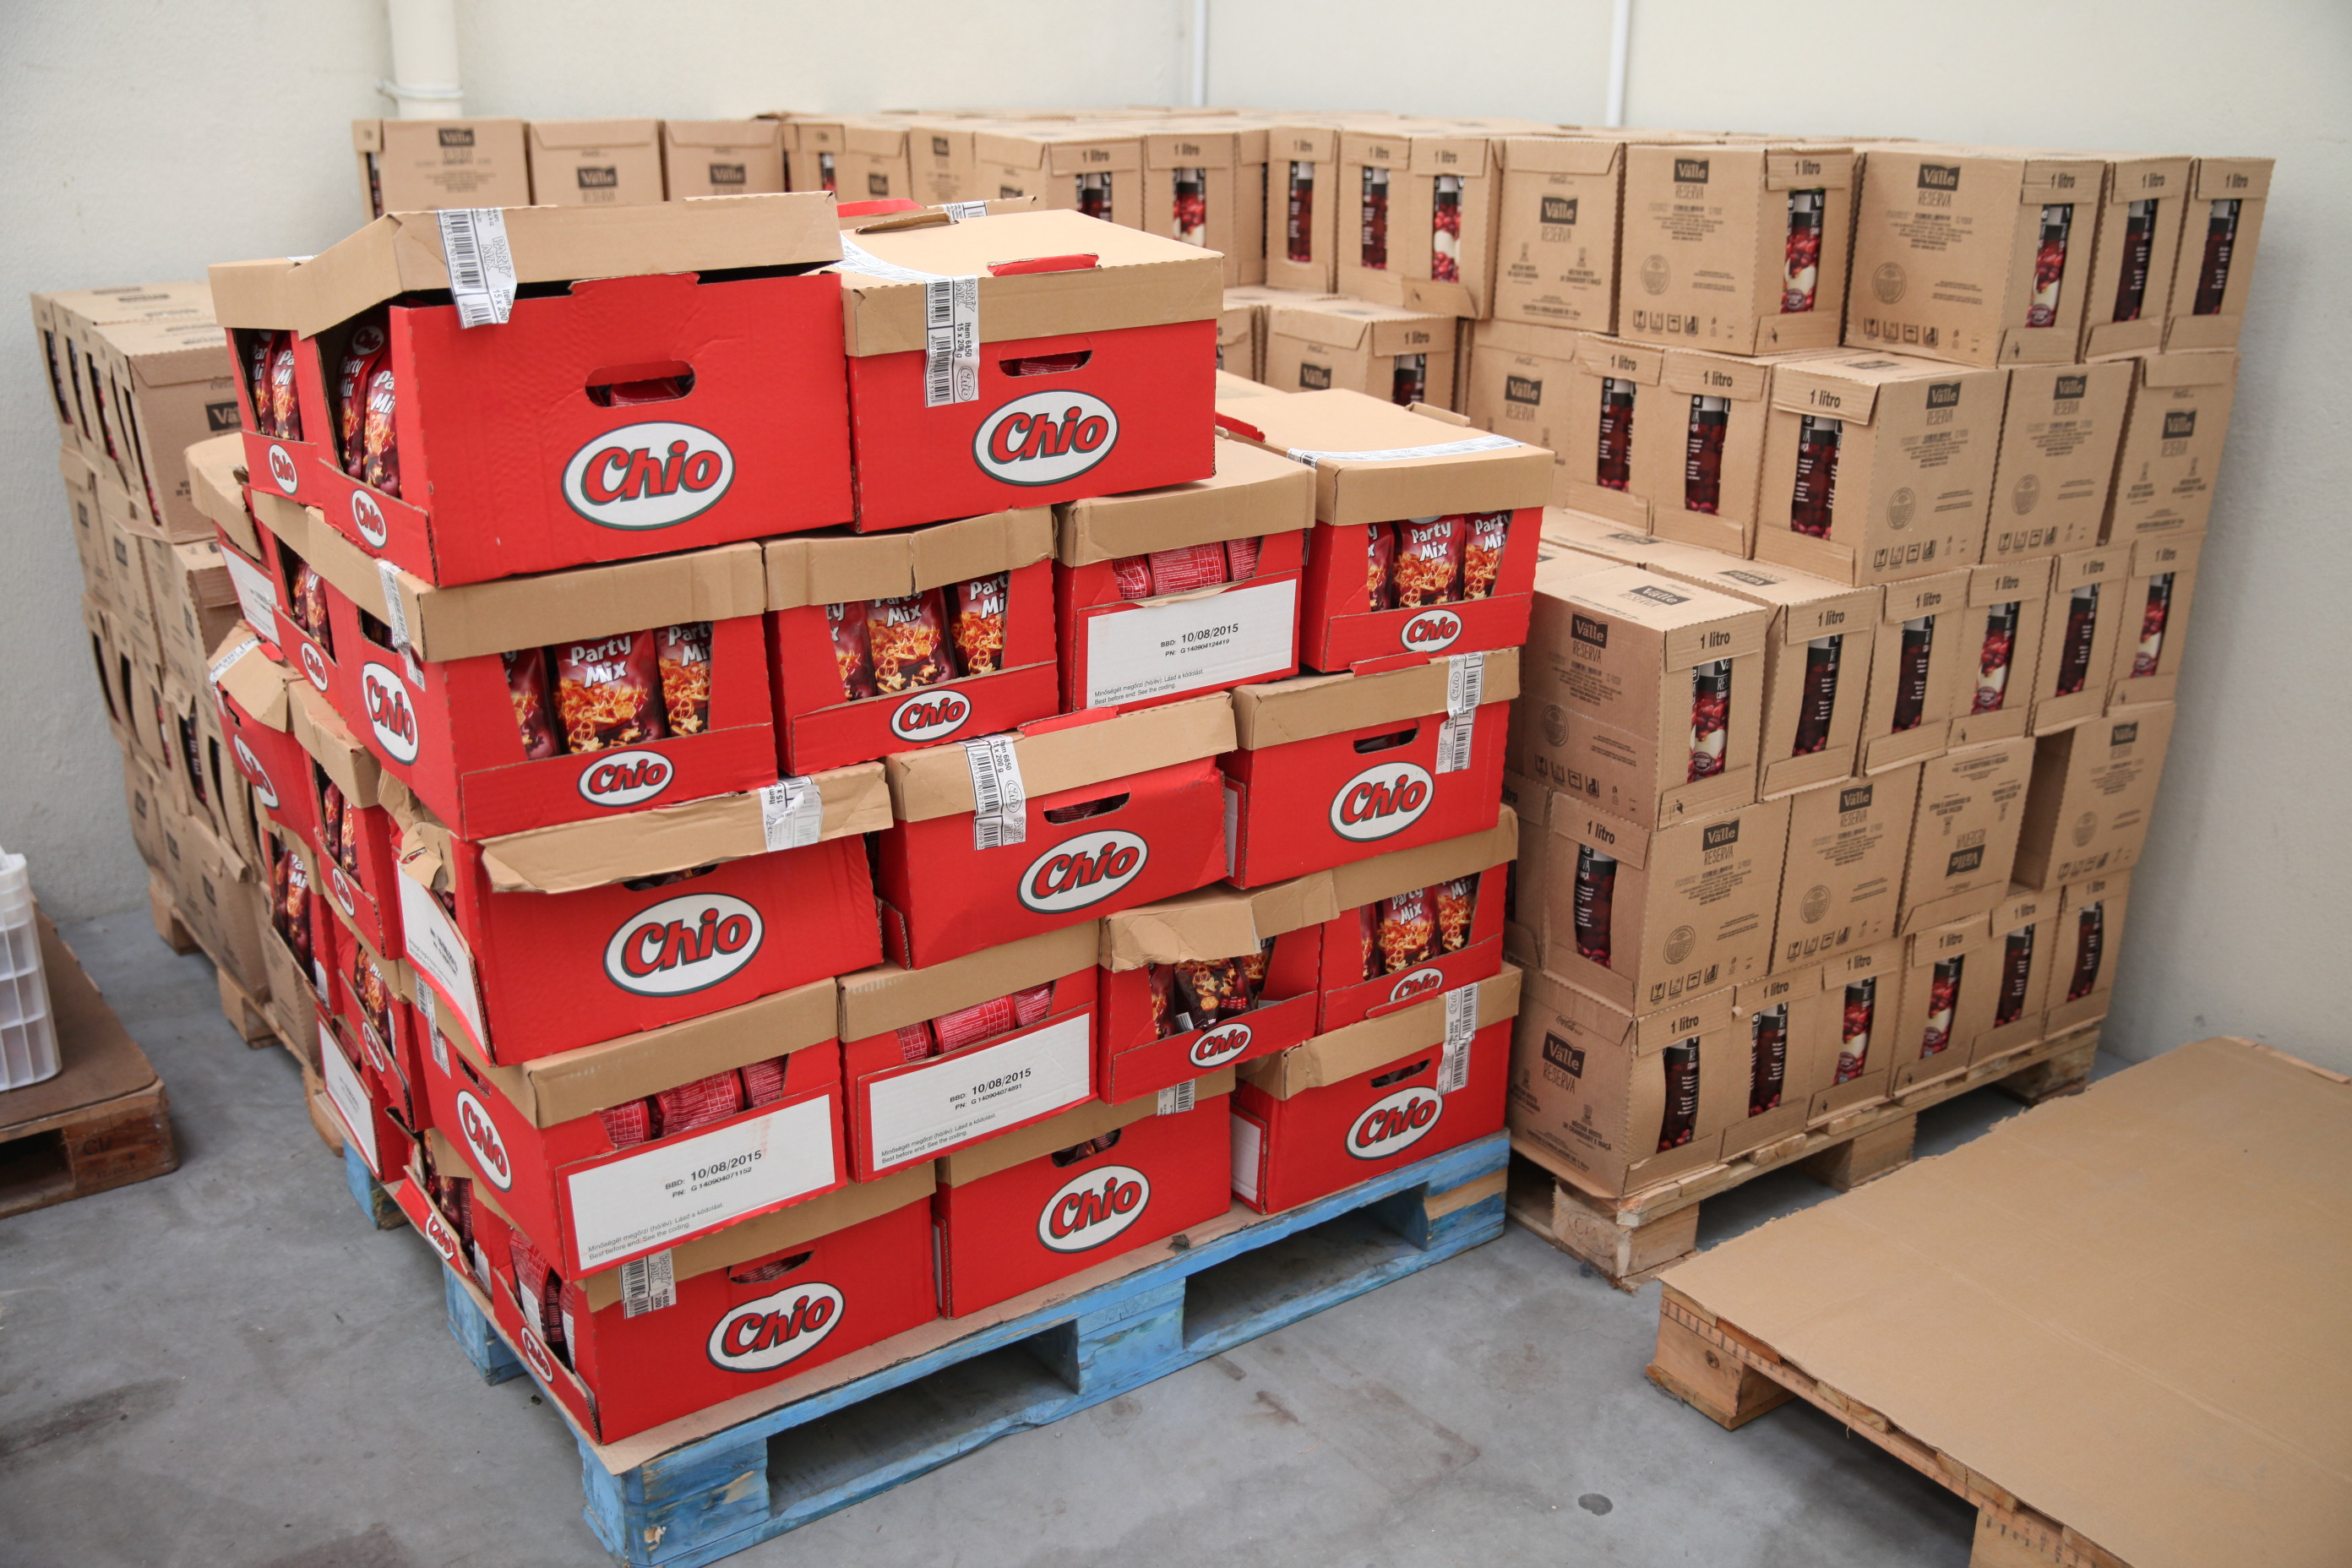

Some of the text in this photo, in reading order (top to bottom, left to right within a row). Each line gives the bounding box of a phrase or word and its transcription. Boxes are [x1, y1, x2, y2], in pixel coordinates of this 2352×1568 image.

[1923, 169, 1956, 186] Valle
[482, 244, 496, 271] MIX
[493, 237, 511, 277] PARTY
[956, 283, 965, 306] MIX
[957, 323, 964, 332] 15
[1618, 355, 1636, 372] litro
[1712, 372, 1733, 388] litro
[1819, 390, 1841, 408] litro
[1931, 388, 1957, 403] Valle
[988, 406, 1109, 466] Chio
[270, 452, 296, 483] Chio
[580, 438, 723, 506] Chio
[355, 498, 384, 538] Chio
[1411, 521, 1451, 543] Party
[1419, 542, 1448, 561] Mix
[2002, 576, 2019, 590] litro
[1642, 586, 1680, 605] Valle
[1924, 593, 1941, 607] litro
[887, 604, 922, 627] Mix
[1826, 611, 1845, 626] litro
[1182, 623, 1239, 643] 10/08/2015
[1408, 618, 1458, 643] Chio
[1576, 618, 1604, 642] Valle
[1700, 632, 1731, 649] 1 litro
[571, 635, 632, 667] Party
[1572, 640, 1602, 664] RESERVA
[304, 647, 325, 682] Chio
[585, 661, 627, 688] Mix
[1164, 674, 1177, 683] Lásd
[1108, 694, 1124, 702] before
[368, 675, 416, 746] Chio
[899, 698, 966, 732] Chio
[995, 754, 1004, 766] 200
[1003, 754, 1012, 770] 6850
[588, 759, 667, 795] Chio
[1340, 774, 1428, 826] Chio
[1843, 792, 1870, 807] Valle
[1594, 823, 1615, 845] litro
[1707, 828, 1735, 844] Valle
[1704, 845, 1734, 866] RESERVA
[1031, 842, 1140, 899] Chio
[1401, 902, 1423, 925] Mix
[621, 907, 753, 978] Chio
[1855, 955, 1872, 969] litro
[1771, 981, 1789, 997] litro
[1680, 1015, 1700, 1032] litro
[364, 1026, 384, 1069] Chio
[1195, 1030, 1249, 1060] Chio
[1549, 1039, 1580, 1071] Valle
[950, 1068, 1032, 1102] BBD: 10/08/2015
[1543, 1061, 1576, 1095] RESERVA
[955, 1123, 968, 1131] Lásd
[1355, 1097, 1437, 1149] Chio
[462, 1101, 508, 1177] Chio
[896, 1150, 912, 1159] before
[665, 1150, 762, 1190] BBD: 10/08/2015
[675, 1214, 690, 1223] Lásd
[1049, 1177, 1142, 1239] Chio
[589, 1251, 604, 1260] Best
[605, 1244, 626, 1255] before
[651, 1262, 661, 1283] MIX
[659, 1253, 671, 1285] PARTY
[721, 1295, 836, 1357] Chio
[524, 1334, 551, 1378] Chio
